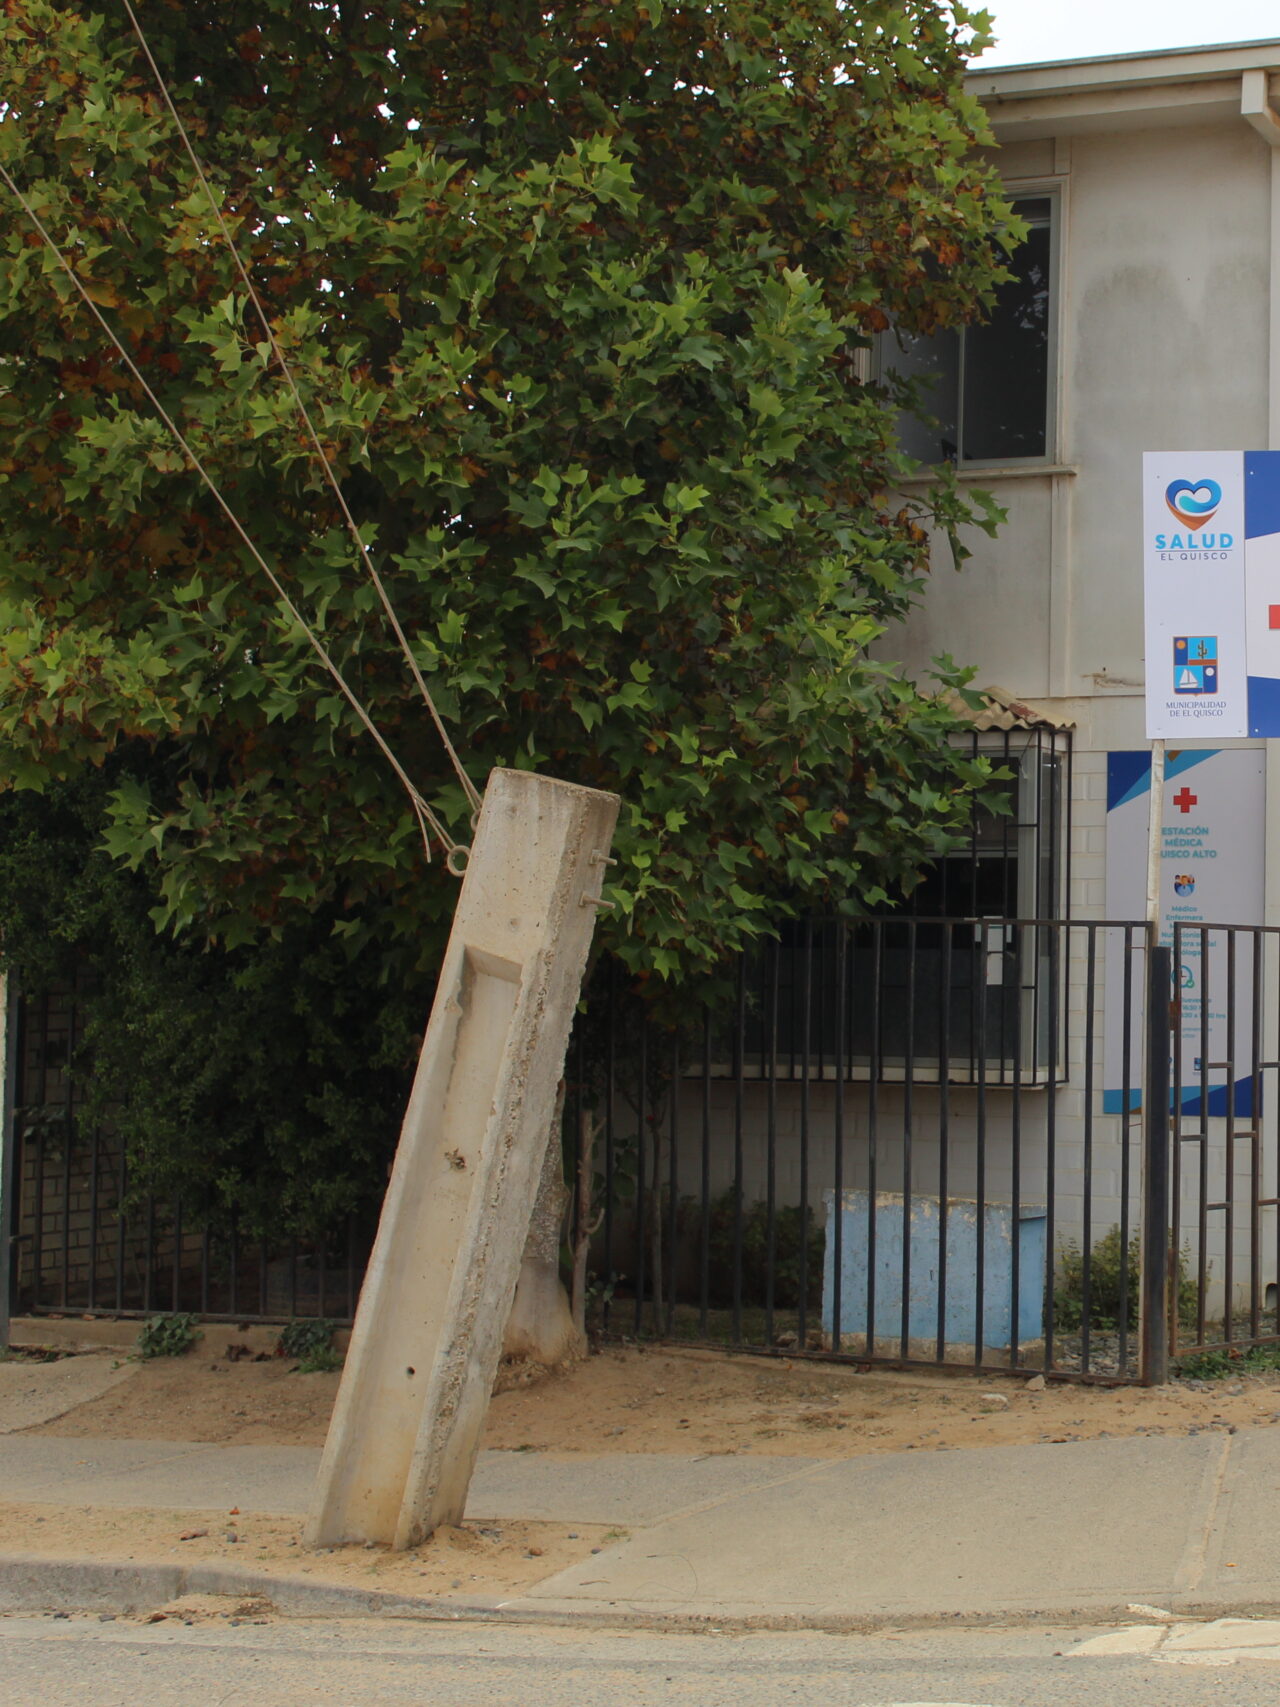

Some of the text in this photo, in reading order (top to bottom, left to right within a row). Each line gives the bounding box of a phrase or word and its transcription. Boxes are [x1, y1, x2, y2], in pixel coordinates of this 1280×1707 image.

[1155, 533, 1233, 549] SALUD
[1160, 552, 1228, 561] EL QUISCO
[1166, 701, 1227, 709] MUNICIPALIDAD
[1193, 709, 1223, 718] QUISCO
[1161, 826, 1209, 836] ESTACIÓN
[1165, 838, 1203, 847] MÉDICA
[1160, 849, 1217, 858] UISCO ALTO
